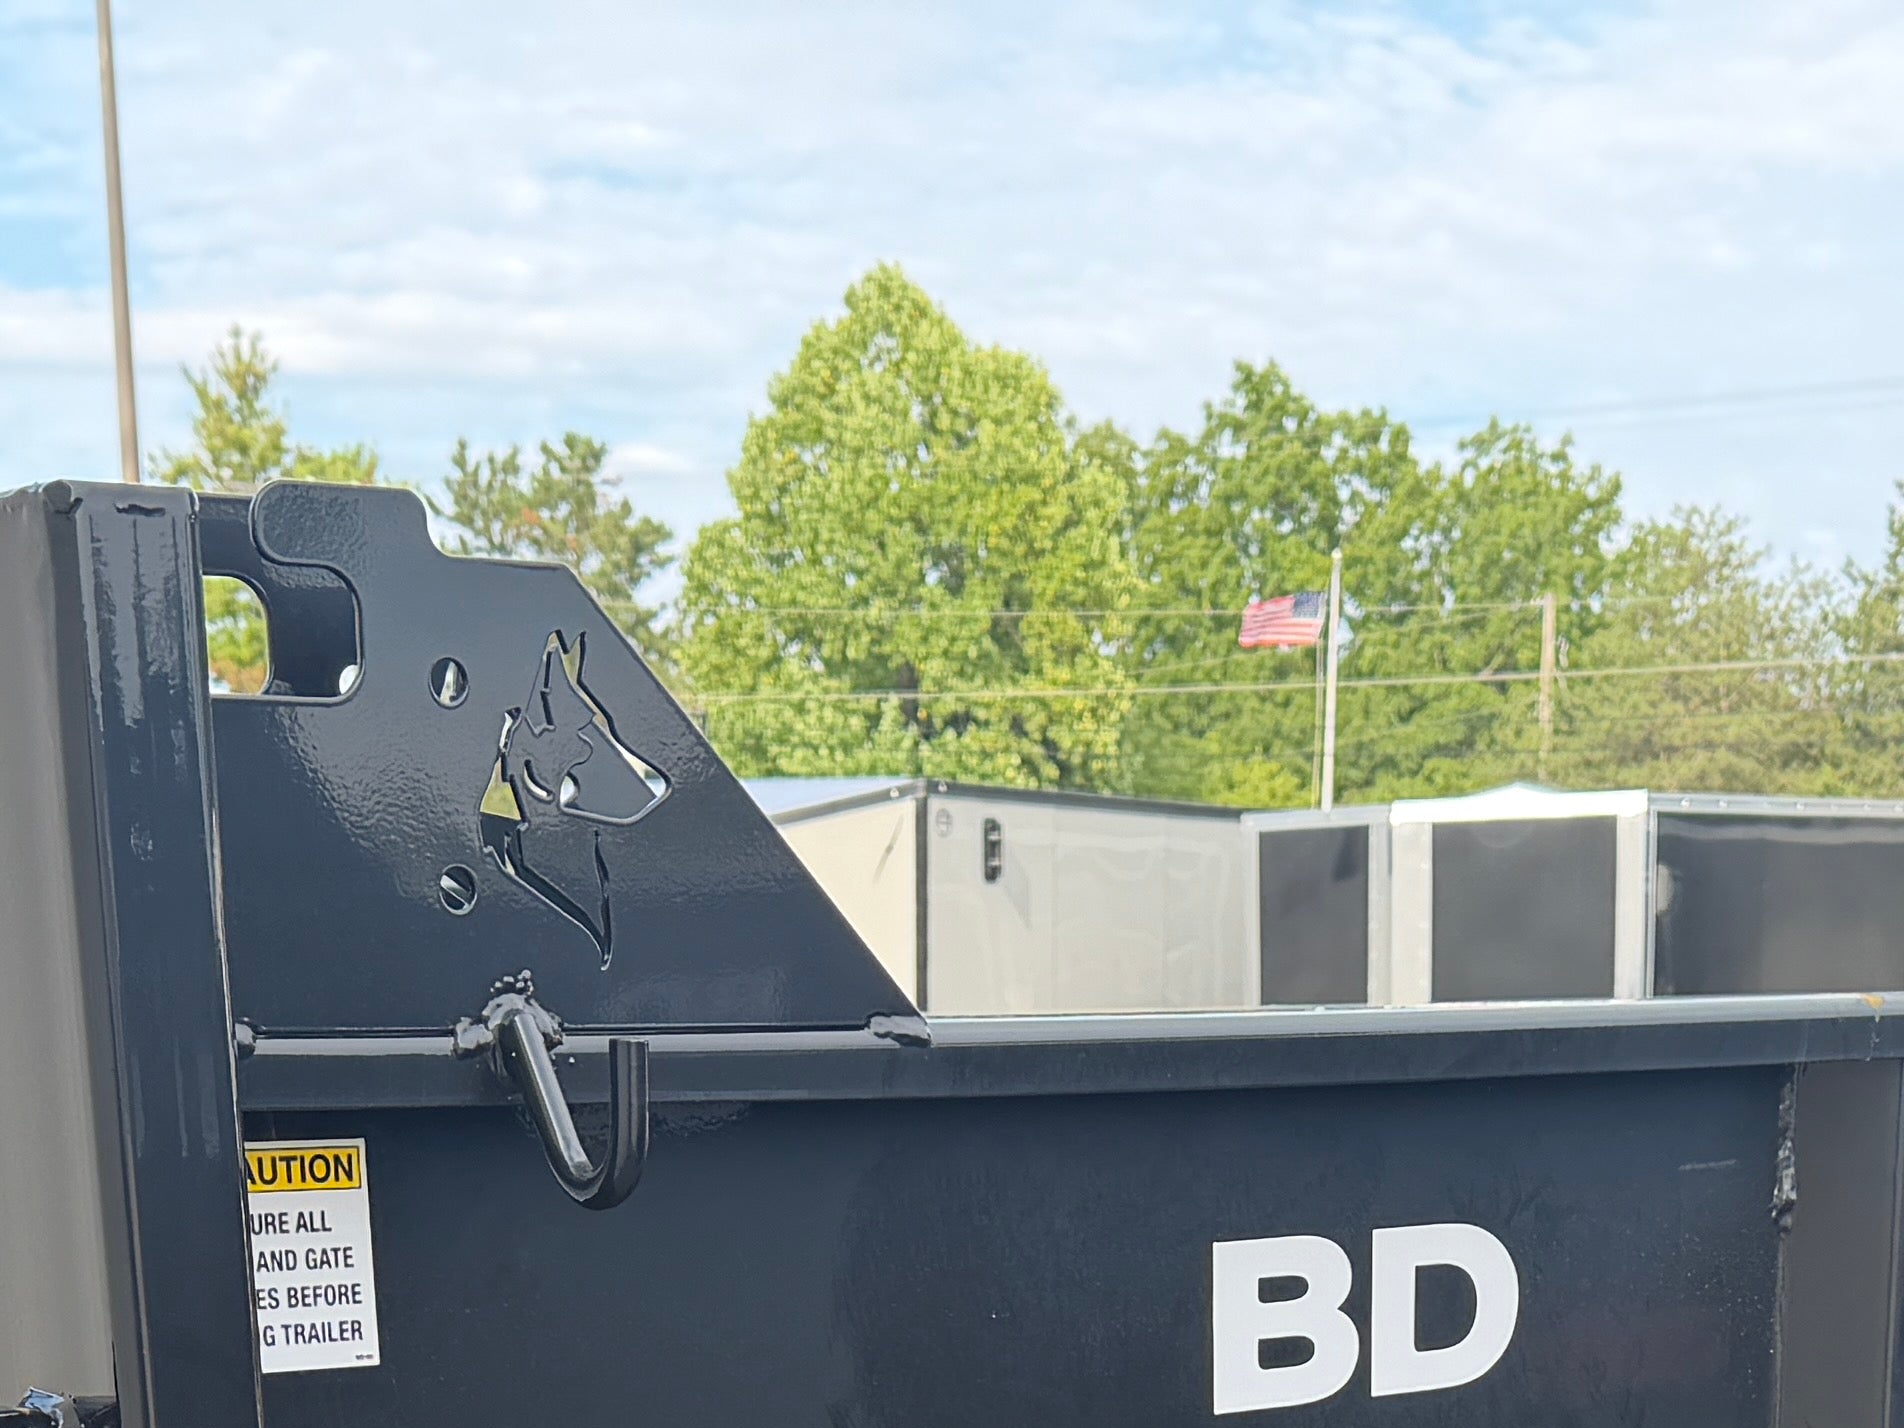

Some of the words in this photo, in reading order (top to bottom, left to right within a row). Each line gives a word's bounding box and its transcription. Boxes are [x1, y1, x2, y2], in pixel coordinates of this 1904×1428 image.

[246, 1153, 353, 1185] UTION
[250, 1212, 290, 1235] URE
[295, 1210, 332, 1233] ALL
[256, 1249, 297, 1272] AND
[305, 1246, 354, 1270] GATE
[287, 1283, 362, 1309] BEFORE
[1212, 1223, 1520, 1416] BD
[280, 1320, 363, 1346] TRAILER
